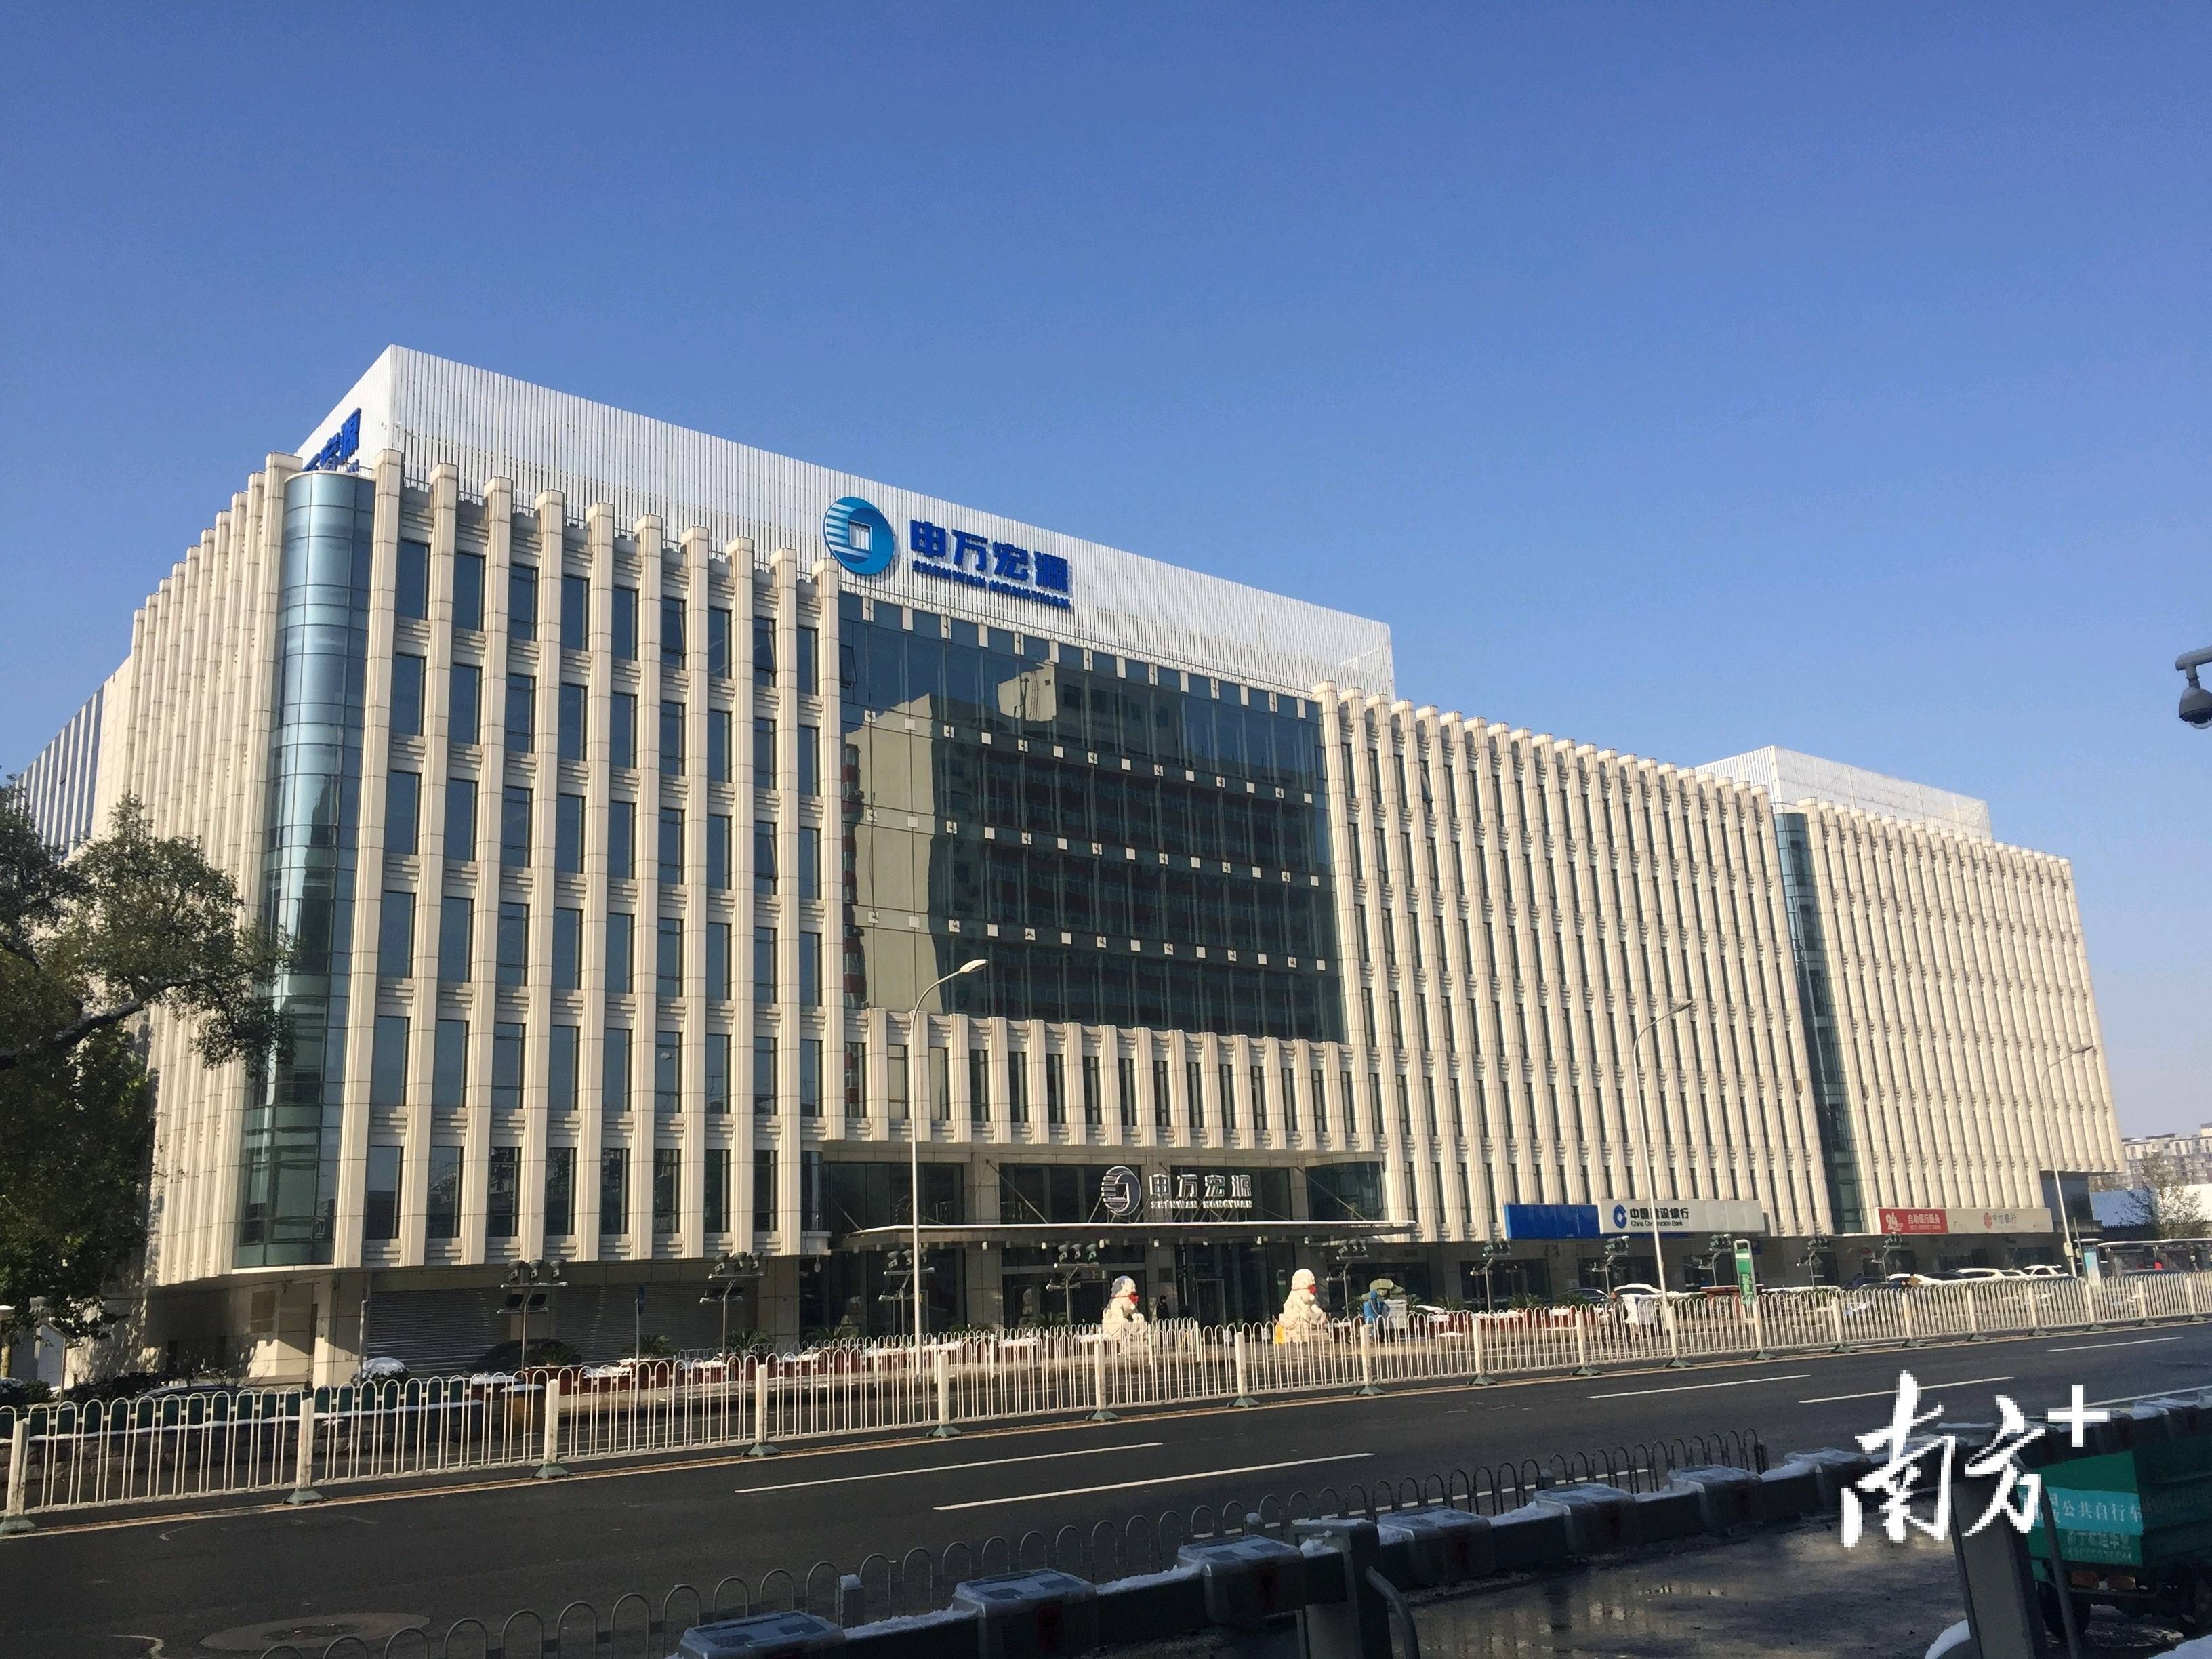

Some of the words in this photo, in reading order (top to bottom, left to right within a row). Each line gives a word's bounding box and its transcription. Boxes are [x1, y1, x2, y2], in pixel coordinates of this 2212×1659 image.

[910, 520, 1069, 592] 申万宏源
[1149, 1174, 1252, 1197] 申万宏源
